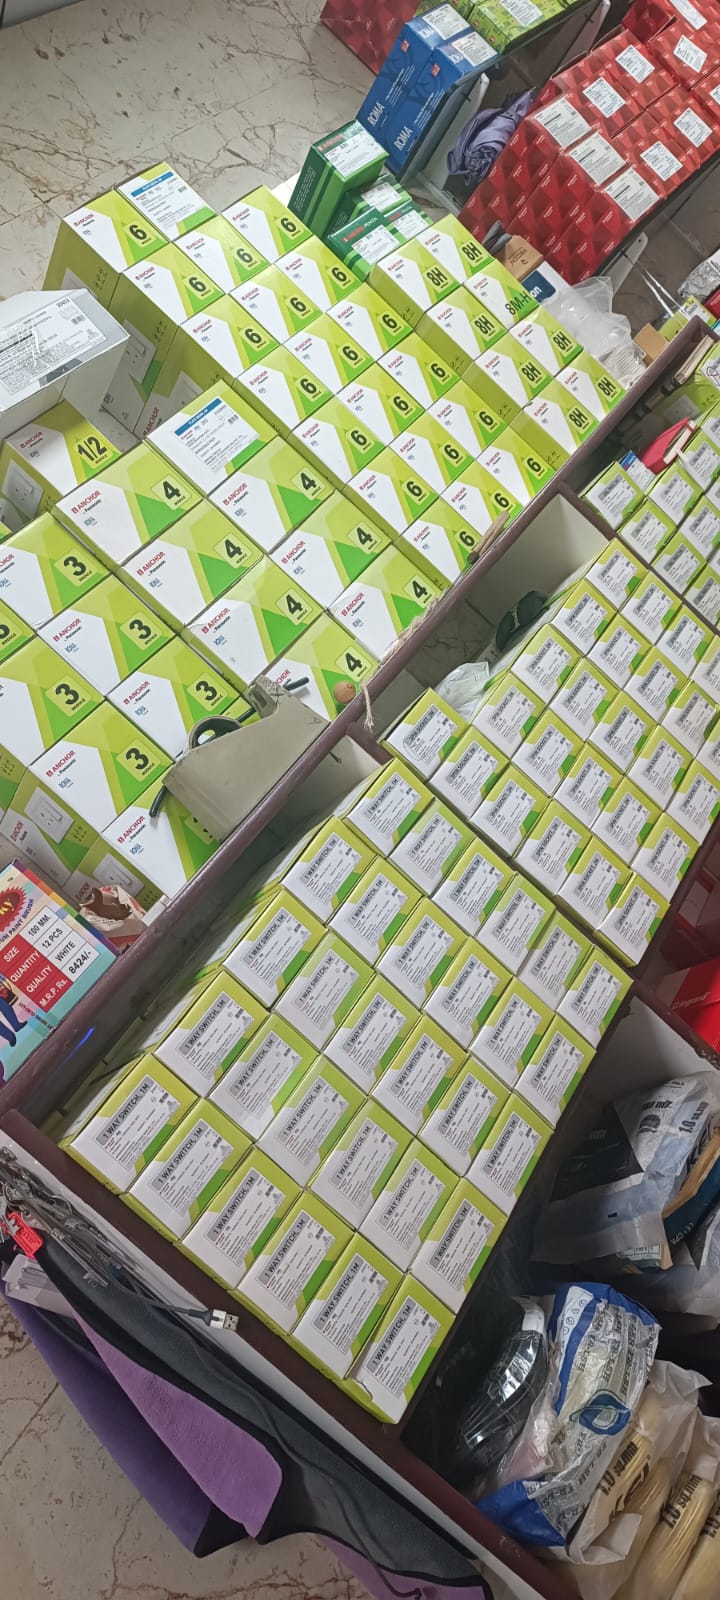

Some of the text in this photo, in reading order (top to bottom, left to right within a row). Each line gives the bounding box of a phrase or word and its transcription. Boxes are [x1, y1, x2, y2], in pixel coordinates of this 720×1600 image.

[367, 101, 385, 127] ROMA
[394, 125, 413, 150] ROMA
[129, 225, 147, 240] 6
[281, 218, 296, 232] 6
[237, 249, 253, 263] 6
[462, 242, 482, 260] 8H
[332, 267, 347, 282] 6
[427, 267, 447, 286] 8H
[189, 277, 206, 292] 6
[530, 286, 542, 297] on
[290, 297, 306, 312] 6
[382, 315, 397, 328] 6
[474, 315, 494, 334] 8H
[245, 329, 262, 343] 6
[553, 332, 571, 350] 8H
[343, 346, 358, 361] 6
[431, 364, 445, 377] 6
[522, 362, 541, 381] 8H
[300, 379, 316, 394] 6
[598, 377, 616, 396] 8H
[393, 396, 408, 411] 6
[479, 412, 493, 425] 6
[569, 408, 587, 427] 8H
[25, 432, 43, 445] ANCHOR
[351, 430, 367, 445] 6
[78, 437, 107, 462] 1/2
[444, 445, 459, 459] 6
[527, 458, 541, 472] 6
[163, 481, 181, 499] 4
[301, 473, 316, 490] 4
[407, 481, 422, 496] 6
[77, 490, 102, 509] ANCHOR
[228, 483, 248, 501] ANCHOR
[495, 493, 509, 508] 6
[357, 527, 373, 545] 4
[459, 531, 474, 546] 6
[225, 539, 242, 558] 4
[286, 540, 305, 560] ANCHOR
[0, 554, 14, 566] CHOR
[64, 556, 86, 576] 3
[143, 551, 165, 572] ANCHOR
[412, 581, 427, 598] 4
[286, 595, 303, 614] 4
[346, 593, 365, 612] ANCHOR
[208, 607, 230, 629] ANCHOR
[59, 618, 81, 637] ANCHOR
[130, 620, 151, 639] 3
[346, 653, 362, 672] 4
[275, 669, 291, 685] CHOR
[56, 684, 79, 705] 3
[129, 681, 150, 700] ANCHOR
[196, 681, 217, 700] 3
[52, 750, 76, 773] ANCHOR
[126, 748, 149, 769] 3
[123, 816, 145, 839] ANCHOR
[9, 919, 24, 936] PAINT
[22, 899, 34, 919] BRUSH
[3, 946, 19, 962] SIZE
[28, 925, 40, 936] 100
[250, 942, 263, 957] WAY
[10, 928, 63, 982] QUANTITY 12 PCS
[26, 965, 52, 993] QUALITY
[55, 940, 76, 961] WHITE
[39, 987, 59, 1007] M.R.P.
[69, 951, 91, 974] 8424/-
[301, 985, 313, 1000] WAY
[187, 1030, 202, 1046] WAY
[349, 1029, 361, 1044] WAY
[237, 1070, 251, 1087] WAY
[105, 1117, 122, 1135] WAY
[285, 1116, 299, 1133] WAY
[443, 1110, 455, 1125] WAY
[679, 1120, 696, 1133] 1.0
[160, 1162, 176, 1180] WAY
[338, 1159, 351, 1176] WAY
[386, 1200, 398, 1217] WAY
[215, 1212, 230, 1231] WAY
[436, 1241, 449, 1258] WAY
[267, 1255, 281, 1274] WAY
[322, 1300, 336, 1319] WAY
[374, 1342, 388, 1361] WAY
[600, 1441, 638, 1496] 1.0 sq.mm
